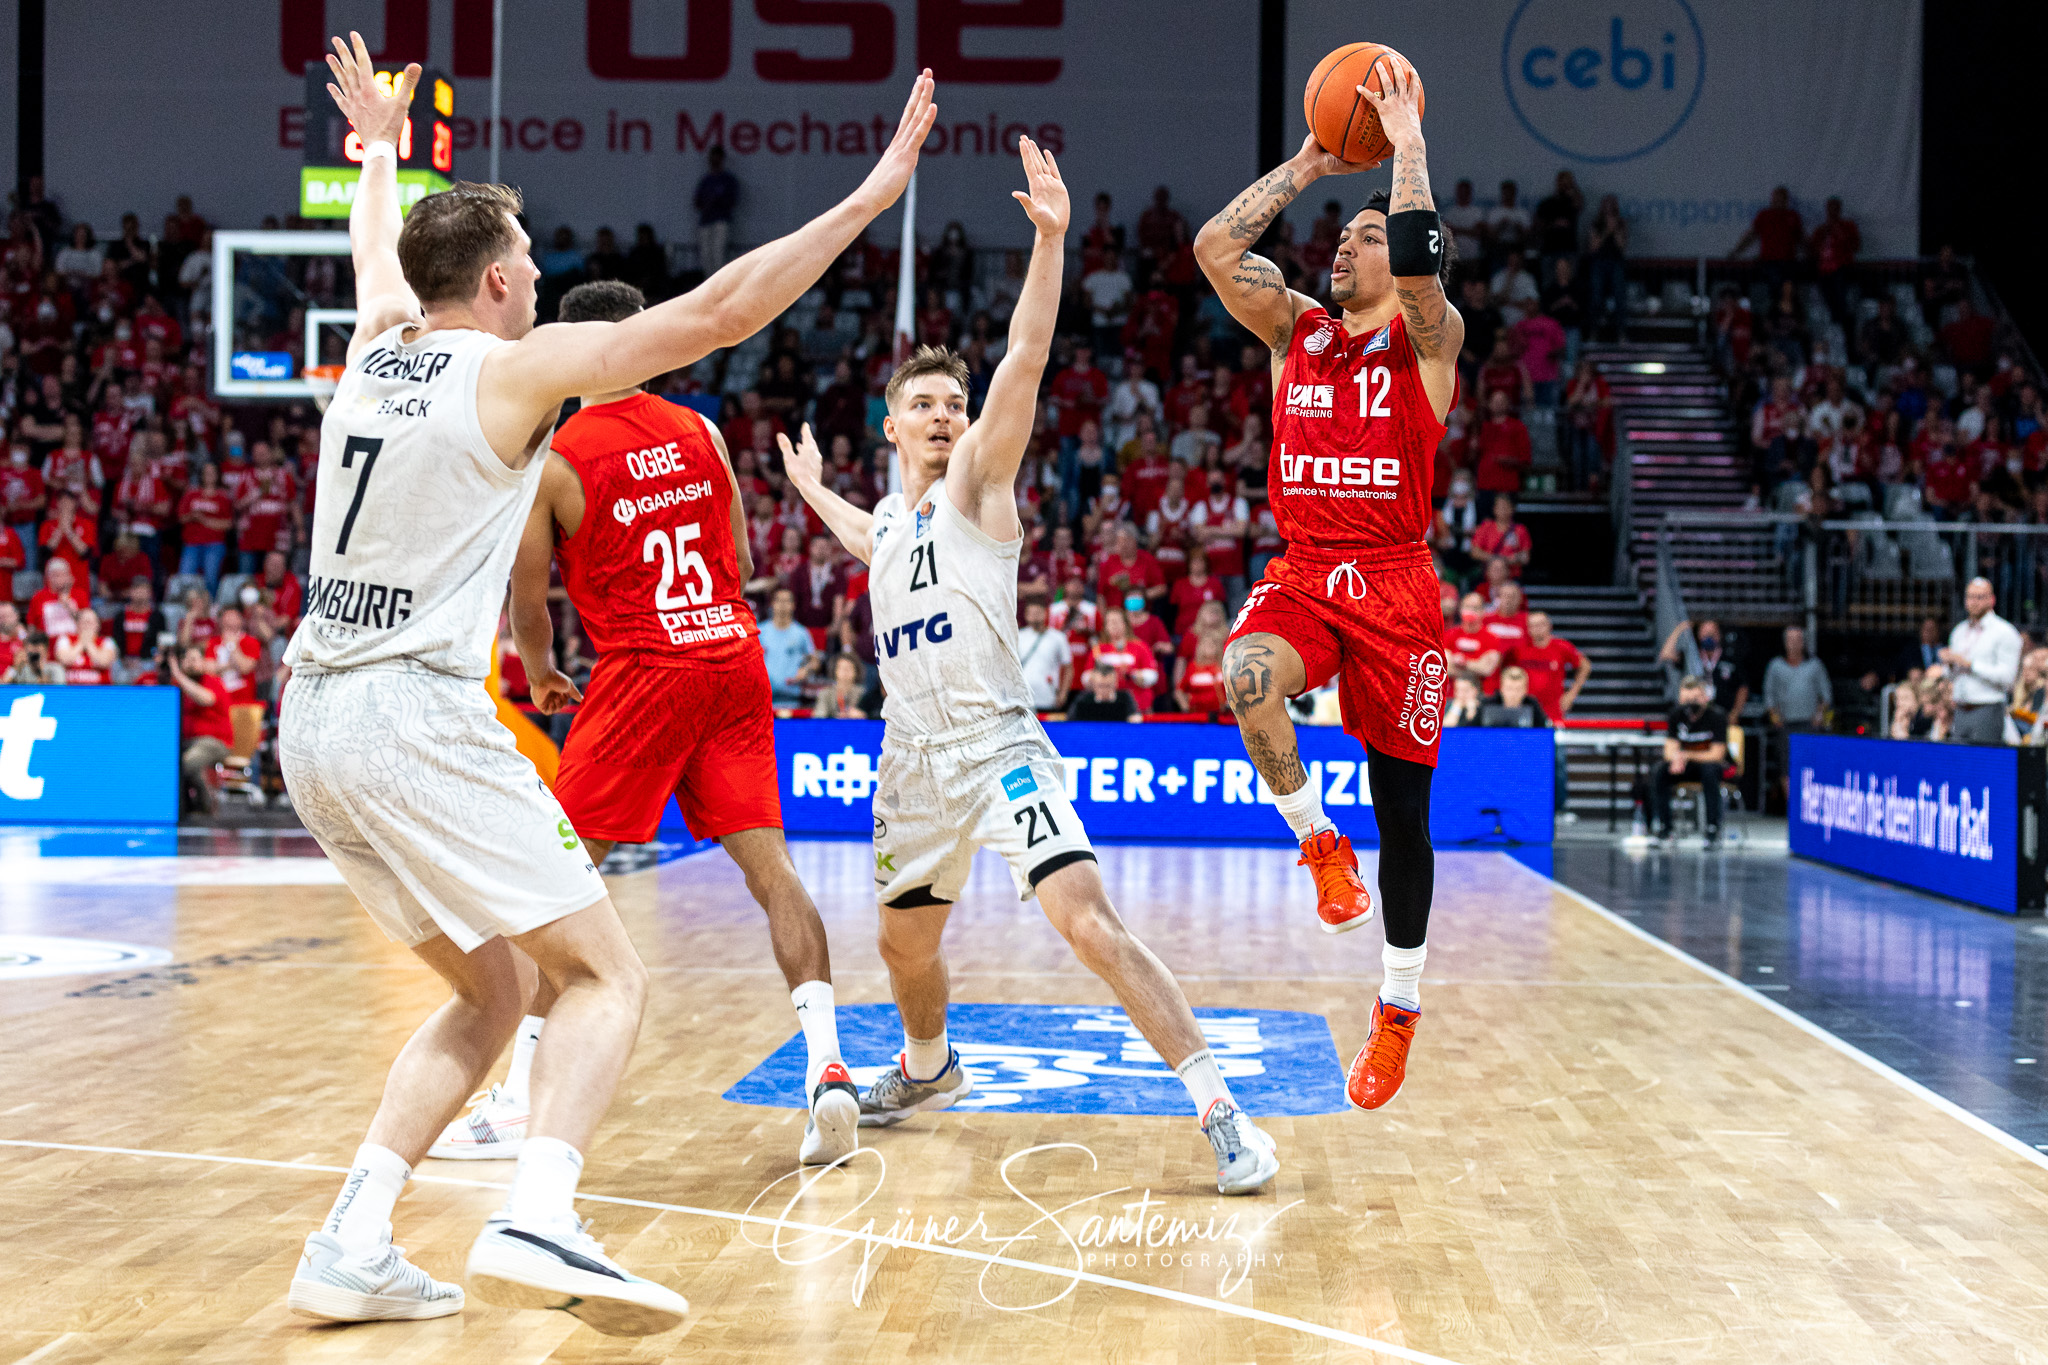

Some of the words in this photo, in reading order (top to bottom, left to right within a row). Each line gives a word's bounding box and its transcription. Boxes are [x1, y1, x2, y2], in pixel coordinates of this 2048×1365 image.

[1522, 16, 1675, 90] cebi
[606, 110, 652, 153] in
[676, 110, 1065, 157] Mechatonics
[1353, 366, 1391, 418] 12
[626, 442, 686, 481] OGBE
[1280, 443, 1400, 487] brose
[335, 435, 384, 556] 7
[636, 480, 713, 515] IGARASHI
[1329, 488, 1397, 500] Mechatronics
[643, 522, 714, 611] 25
[910, 541, 939, 592] 21
[657, 604, 736, 630] brose
[668, 623, 748, 645] bamberg
[883, 612, 953, 659] VTG
[1397, 652, 1419, 729] AUTOMATION
[1014, 801, 1062, 849] 21
